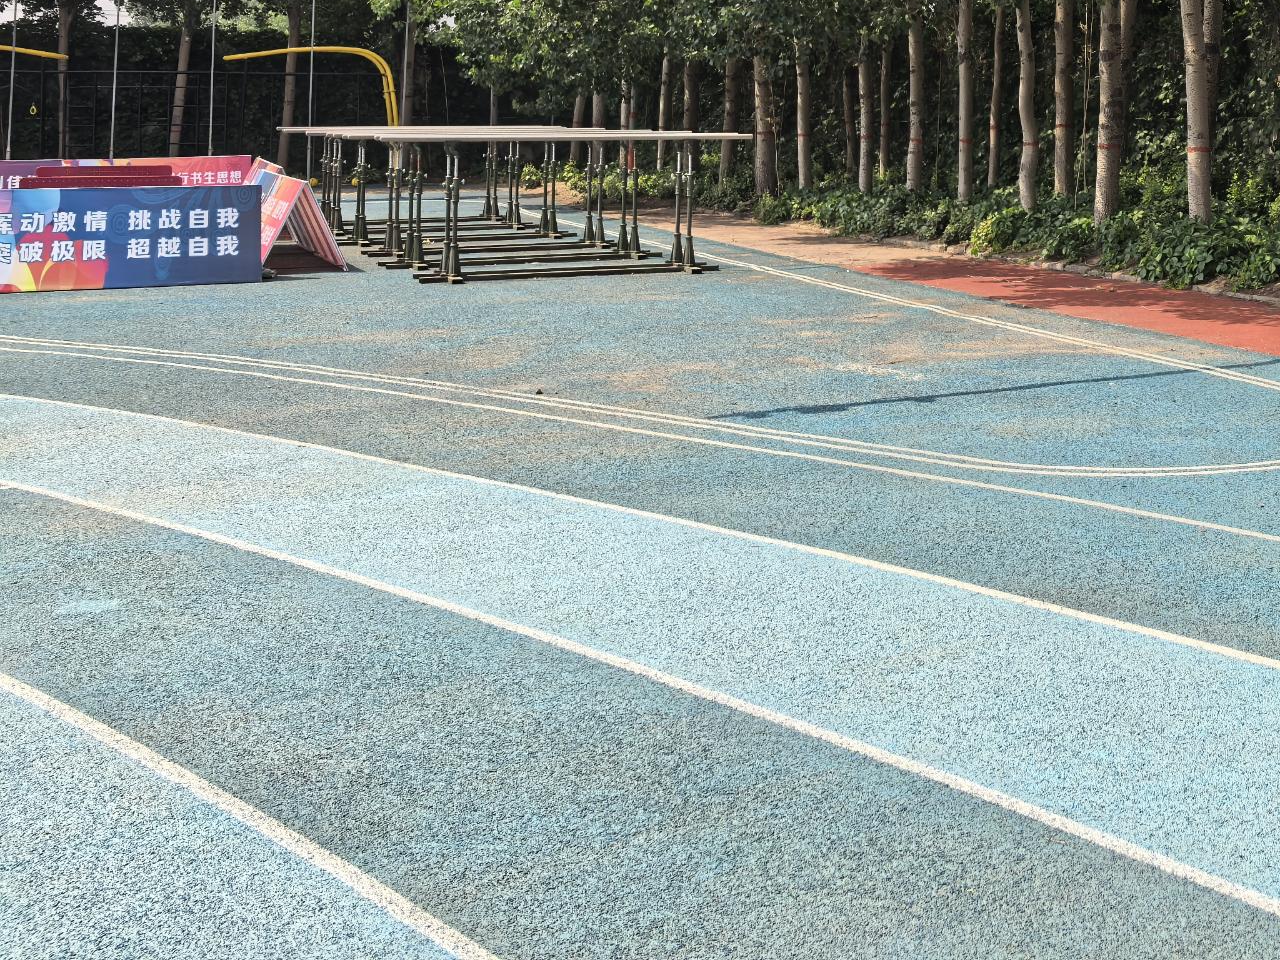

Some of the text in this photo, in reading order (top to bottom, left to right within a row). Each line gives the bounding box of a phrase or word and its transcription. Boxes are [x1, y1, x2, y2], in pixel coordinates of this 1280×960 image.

[128, 207, 239, 231] 挑战自我
[127, 235, 239, 259] 超越自我
